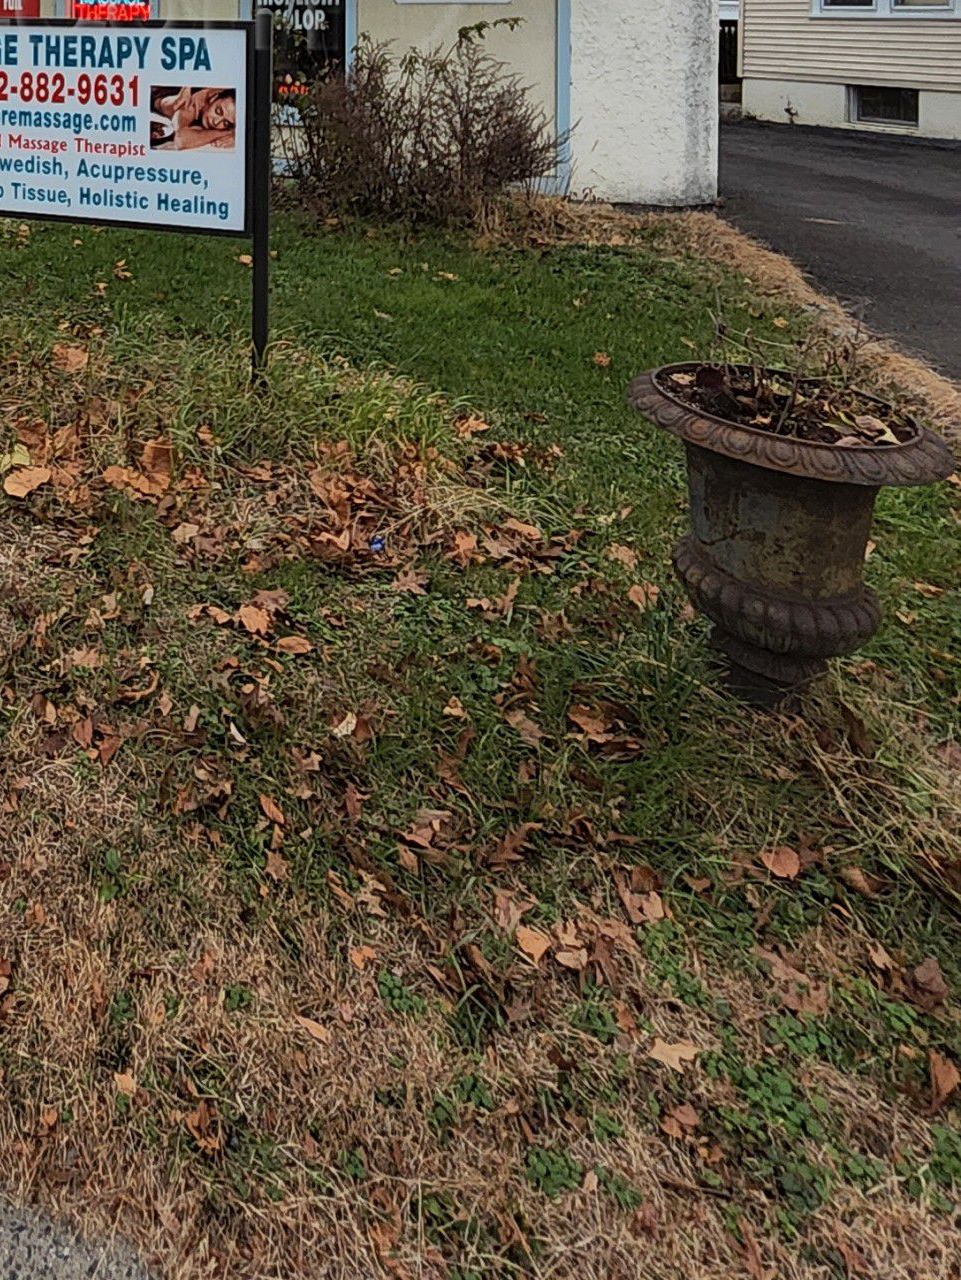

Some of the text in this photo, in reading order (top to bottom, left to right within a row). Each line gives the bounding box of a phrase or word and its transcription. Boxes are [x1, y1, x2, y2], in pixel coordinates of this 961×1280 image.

[75, 4, 151, 22] THERAPY
[29, 34, 150, 69] THERAPY
[160, 36, 212, 71] SPA
[8, 134, 68, 153] Massage
[74, 137, 146, 158] Therapist
[76, 158, 209, 190] Acupressure,
[11, 182, 72, 207] Tissue,
[79, 186, 149, 210] Holistic
[157, 192, 229, 220] Healing
